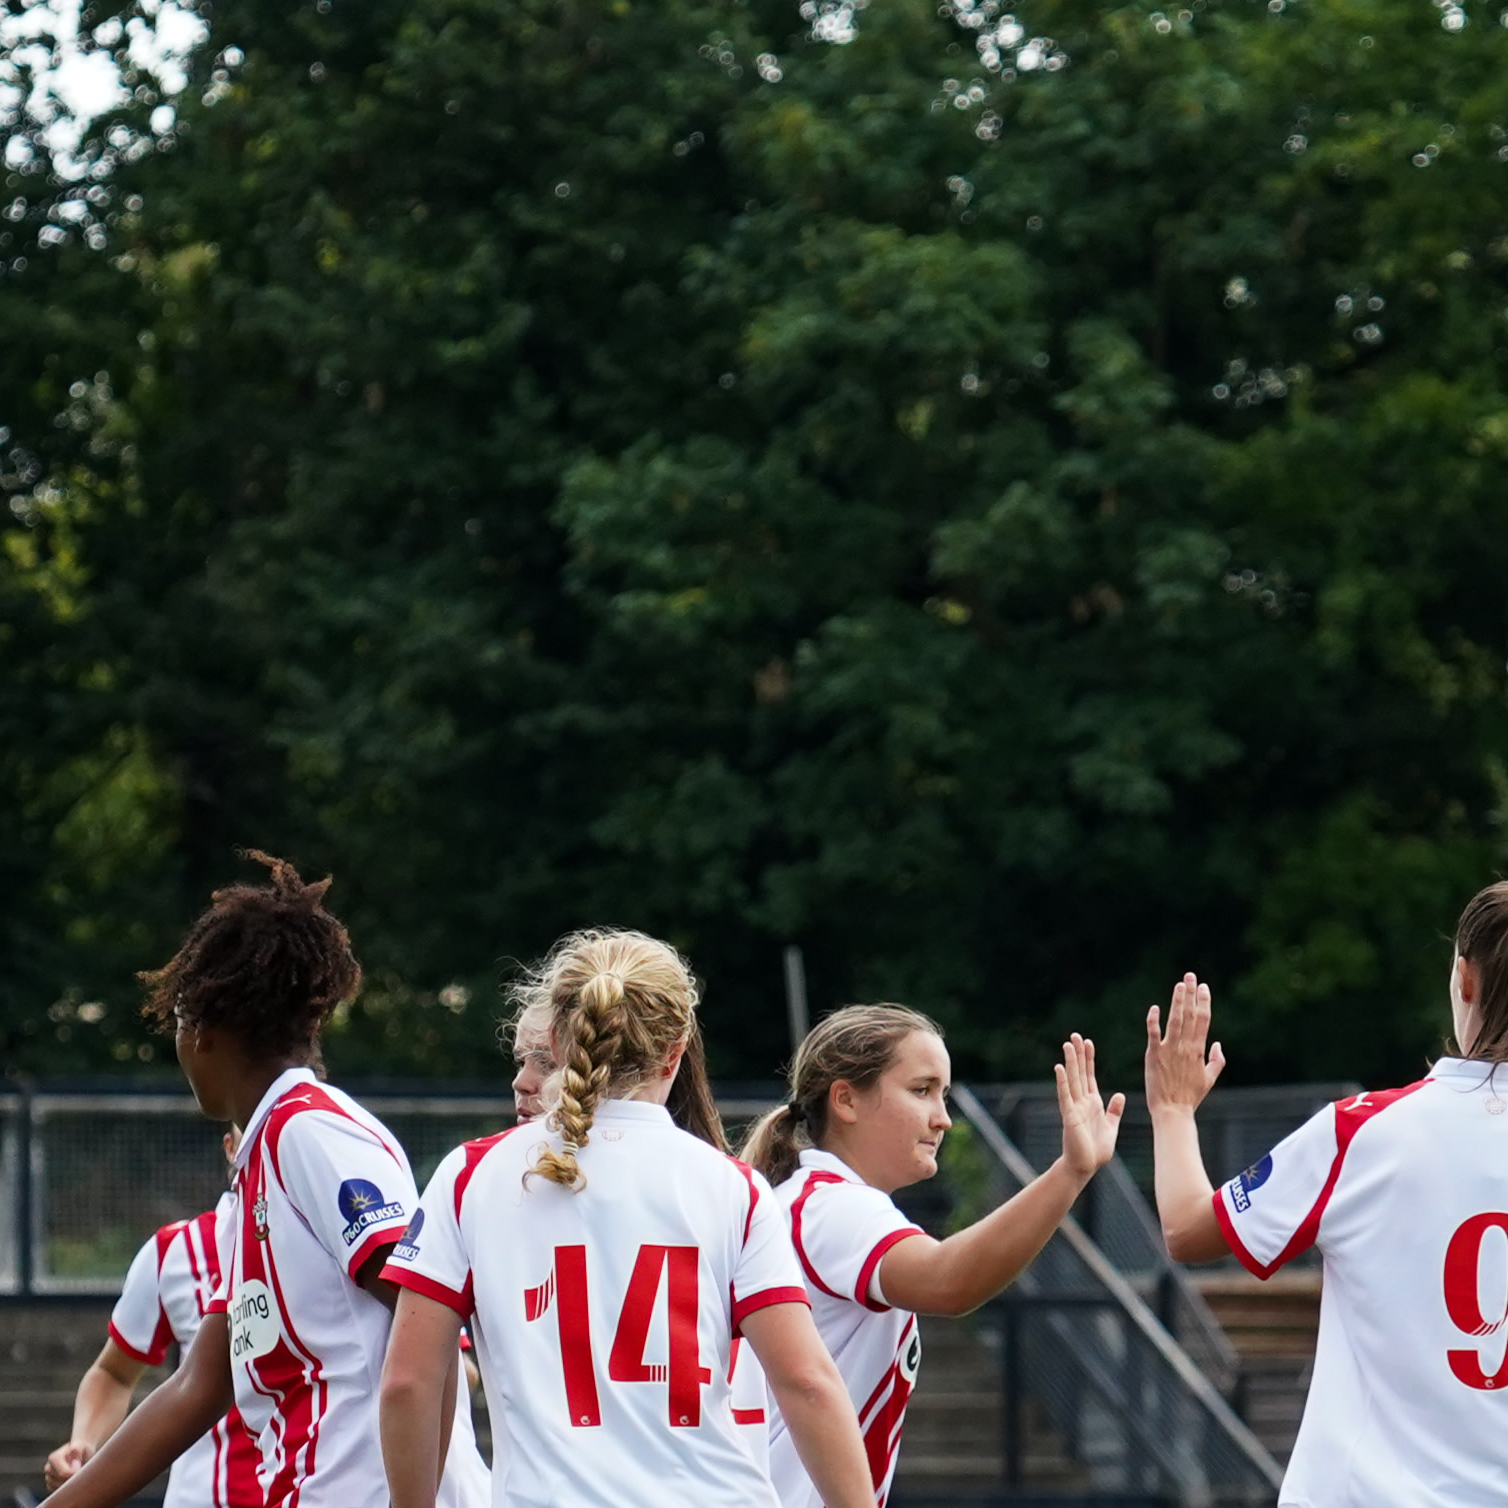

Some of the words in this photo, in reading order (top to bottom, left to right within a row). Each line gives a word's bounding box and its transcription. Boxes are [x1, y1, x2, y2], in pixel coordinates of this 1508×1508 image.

[359, 1204, 404, 1226] CRUISES
[233, 1326, 254, 1356] ank
[524, 1244, 712, 1427] 14
